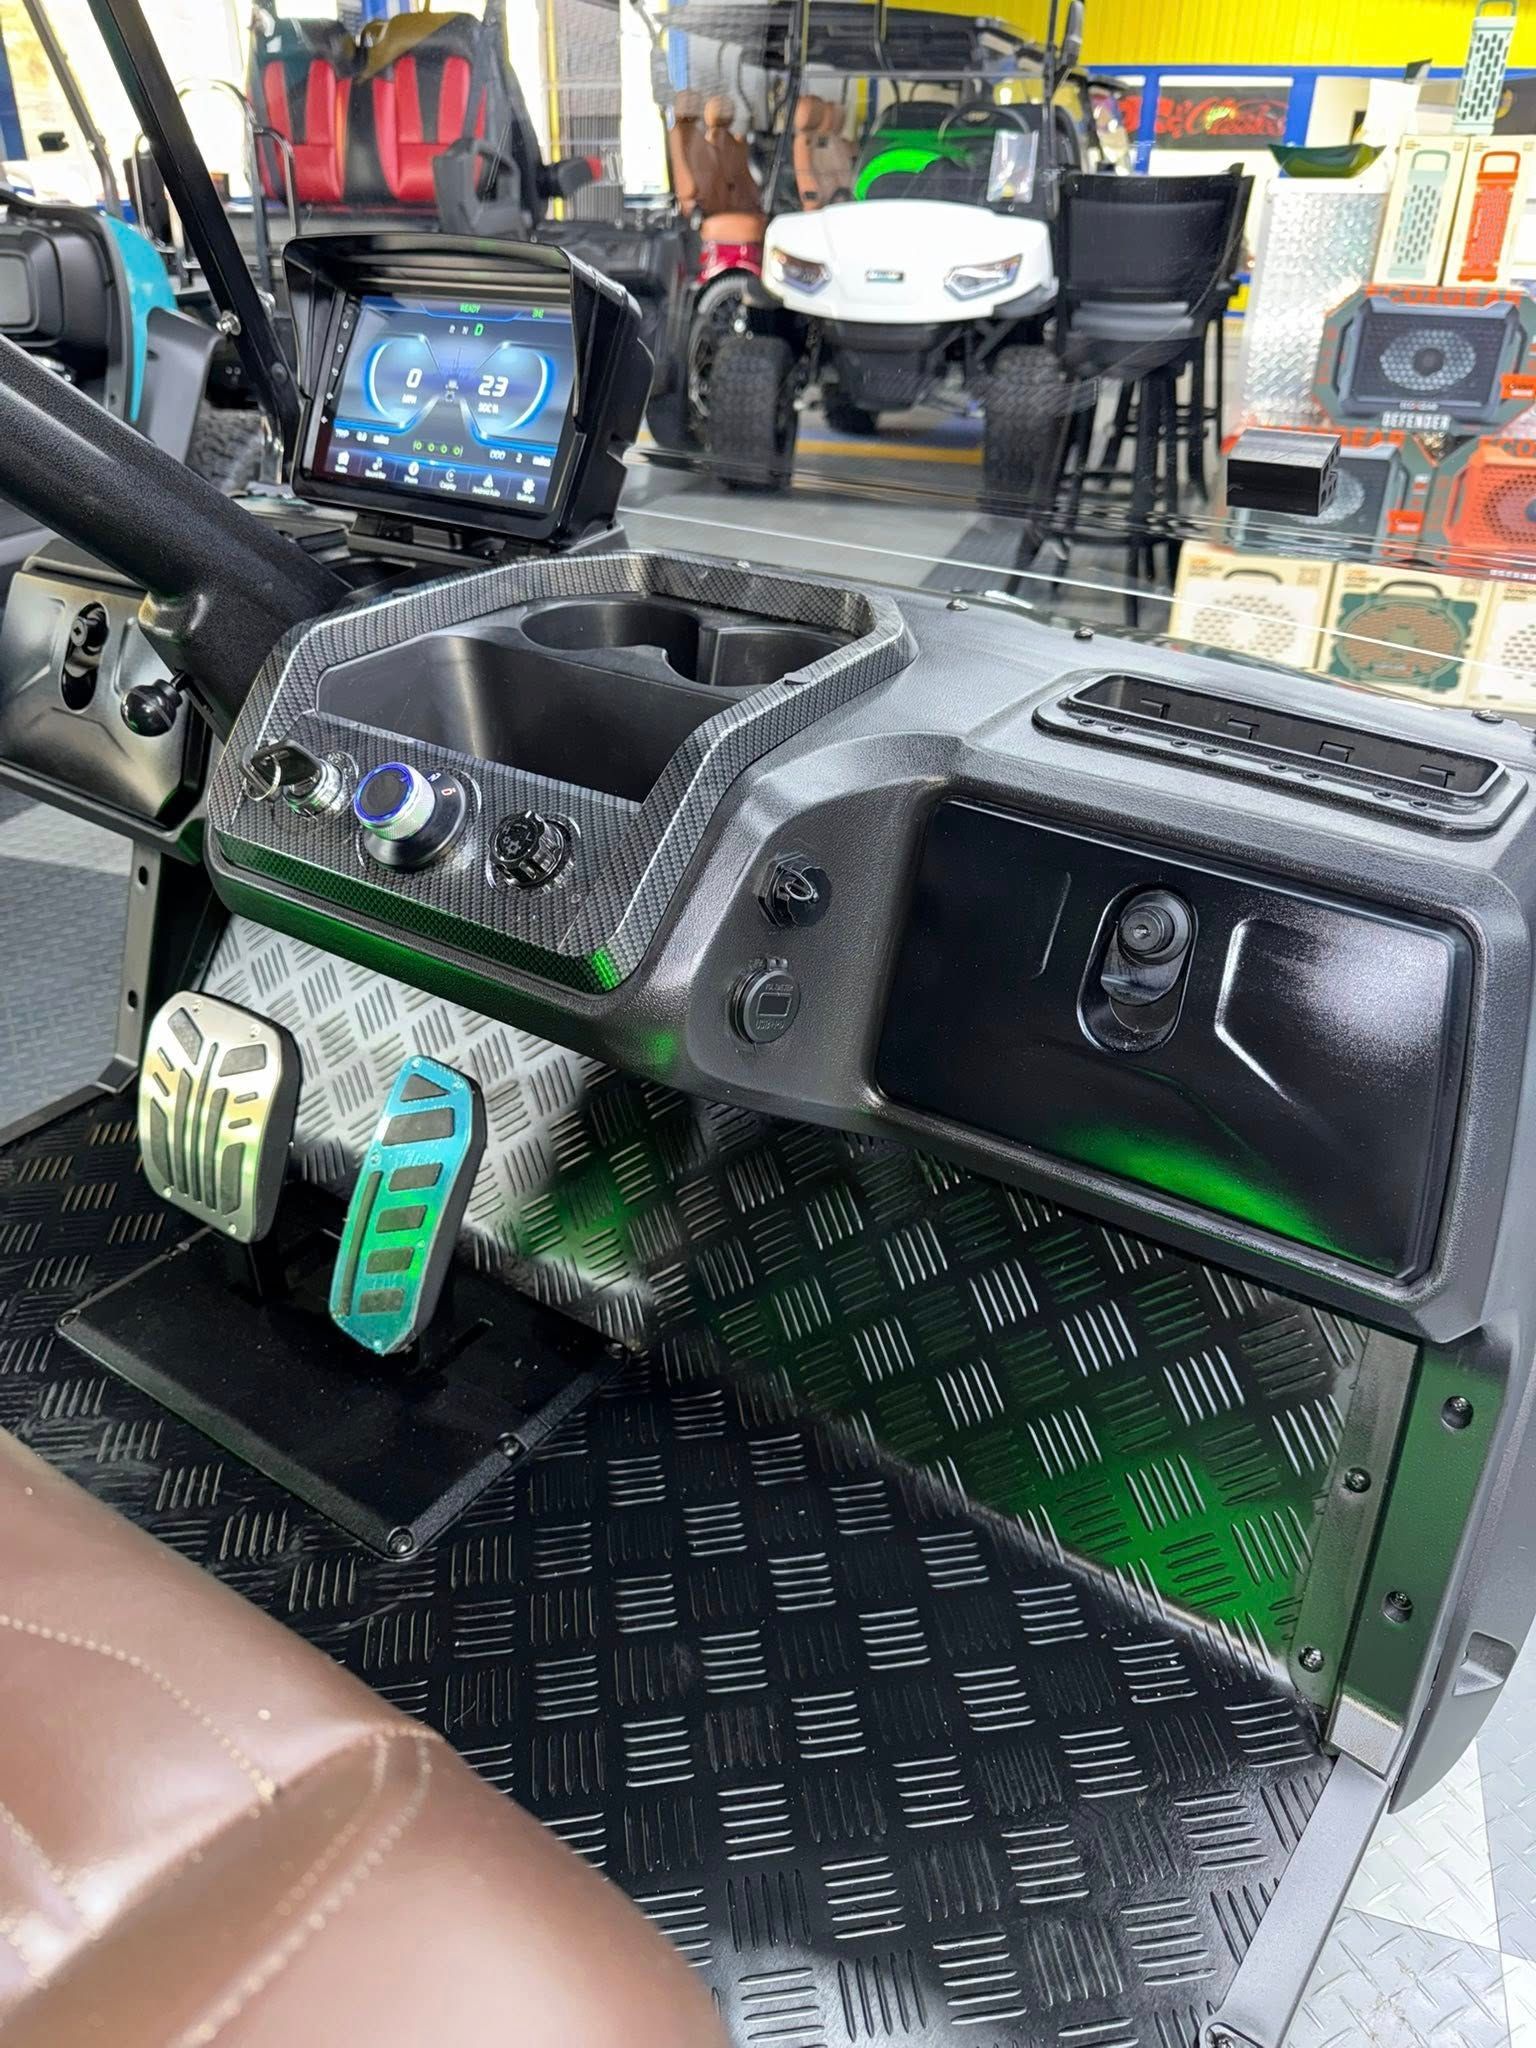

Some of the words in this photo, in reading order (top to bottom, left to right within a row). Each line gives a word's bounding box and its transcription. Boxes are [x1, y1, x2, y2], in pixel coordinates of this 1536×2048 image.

[474, 323, 485, 337] D
[406, 367, 423, 389] 0
[477, 375, 509, 398] 23
[1381, 411, 1451, 431] DEFENDER
